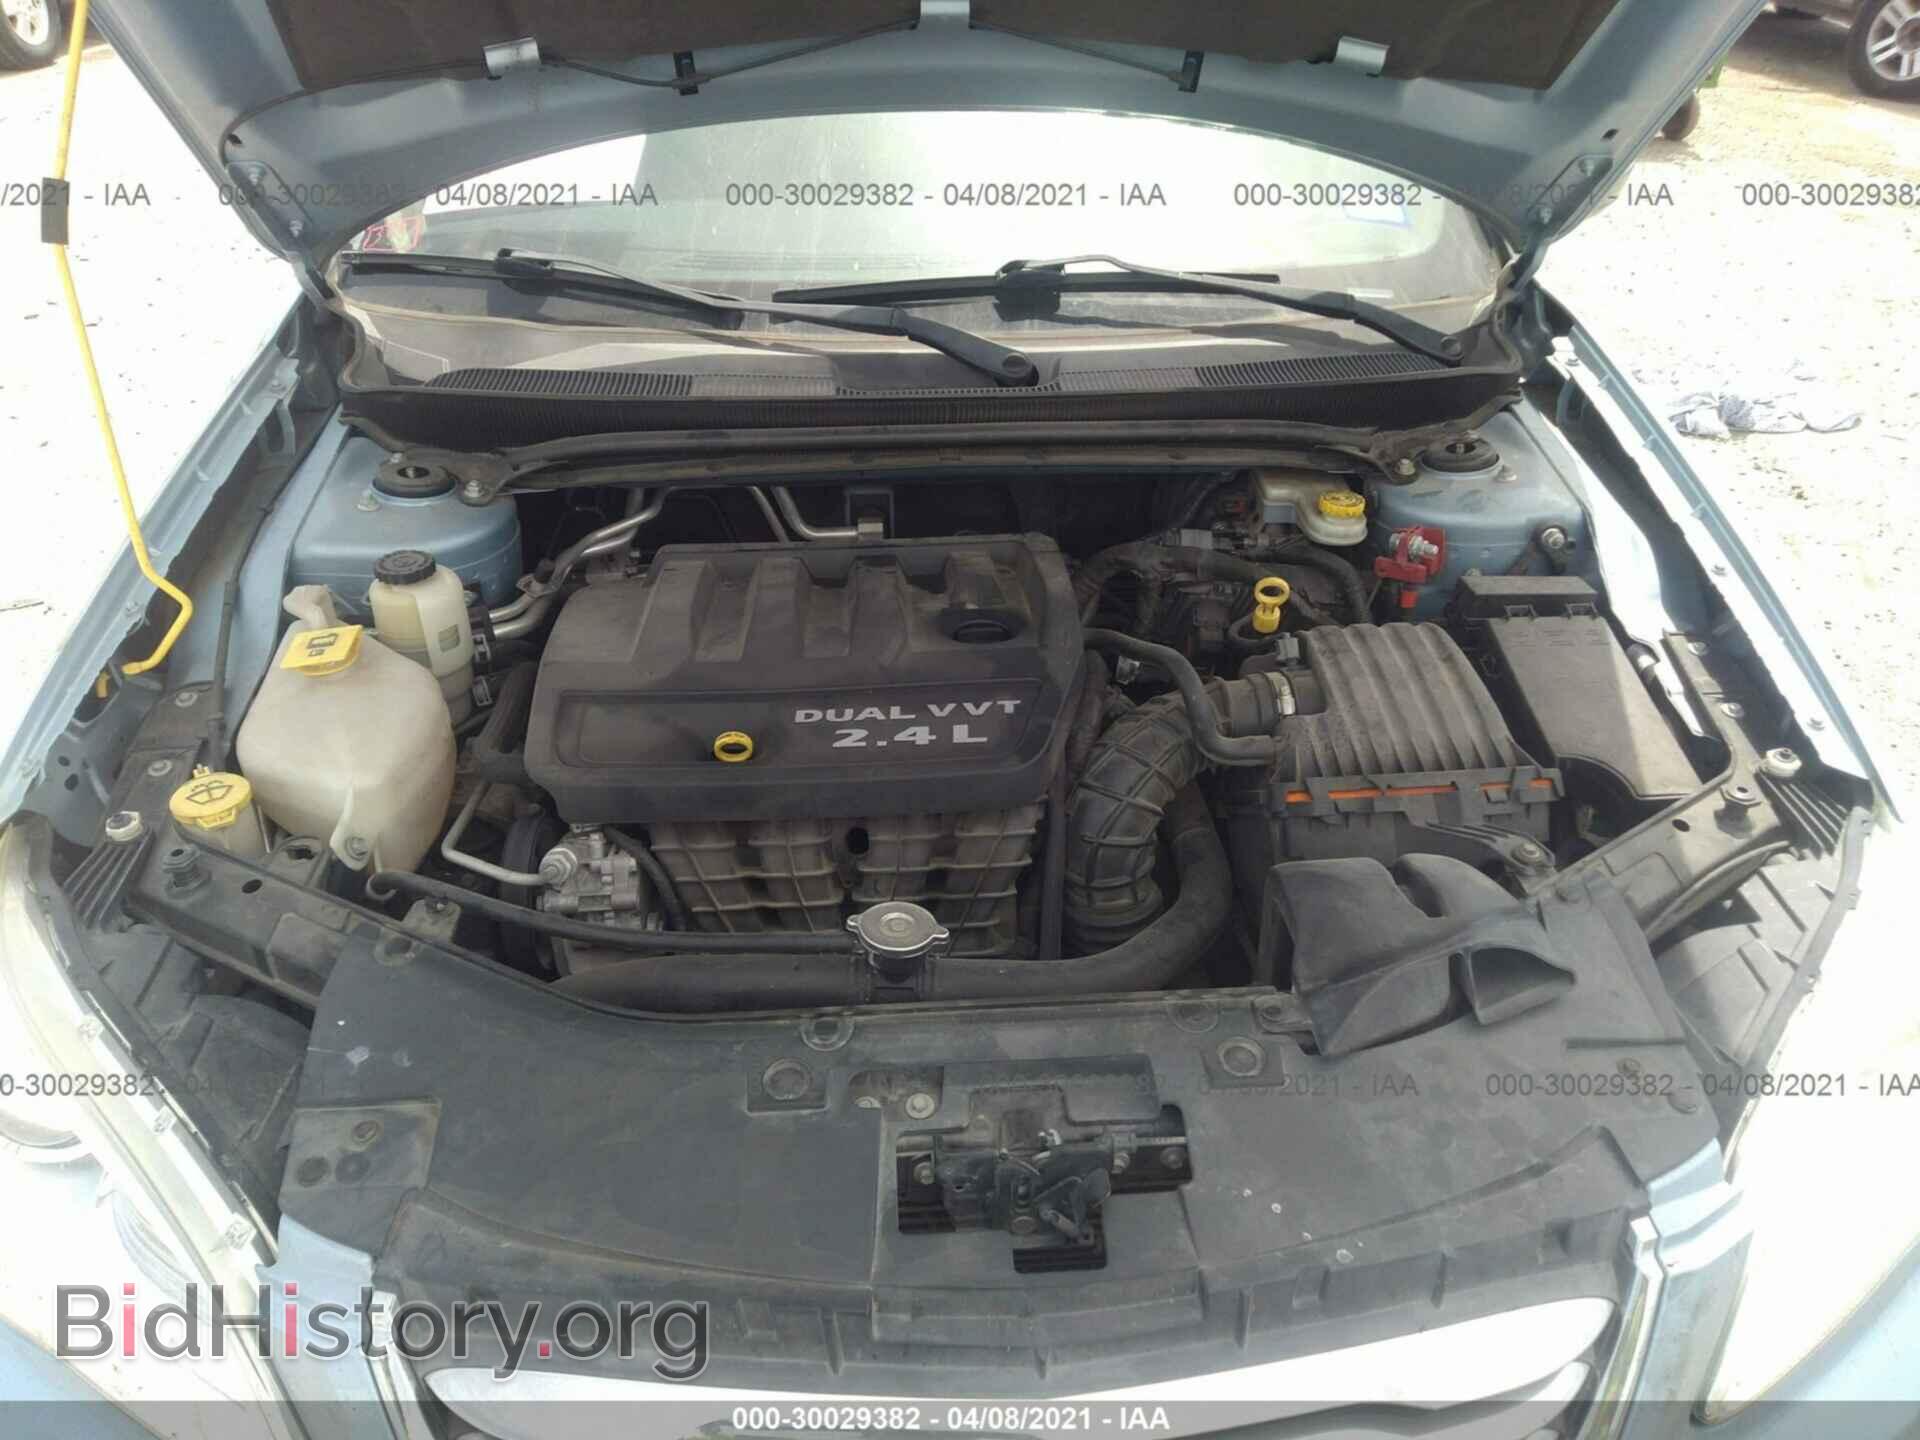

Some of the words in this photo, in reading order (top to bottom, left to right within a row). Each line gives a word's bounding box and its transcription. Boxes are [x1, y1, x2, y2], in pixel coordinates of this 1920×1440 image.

[795, 705, 916, 724] DUAL
[927, 700, 1021, 717] VVT
[832, 726, 937, 747] 2.4
[952, 724, 988, 743] L
